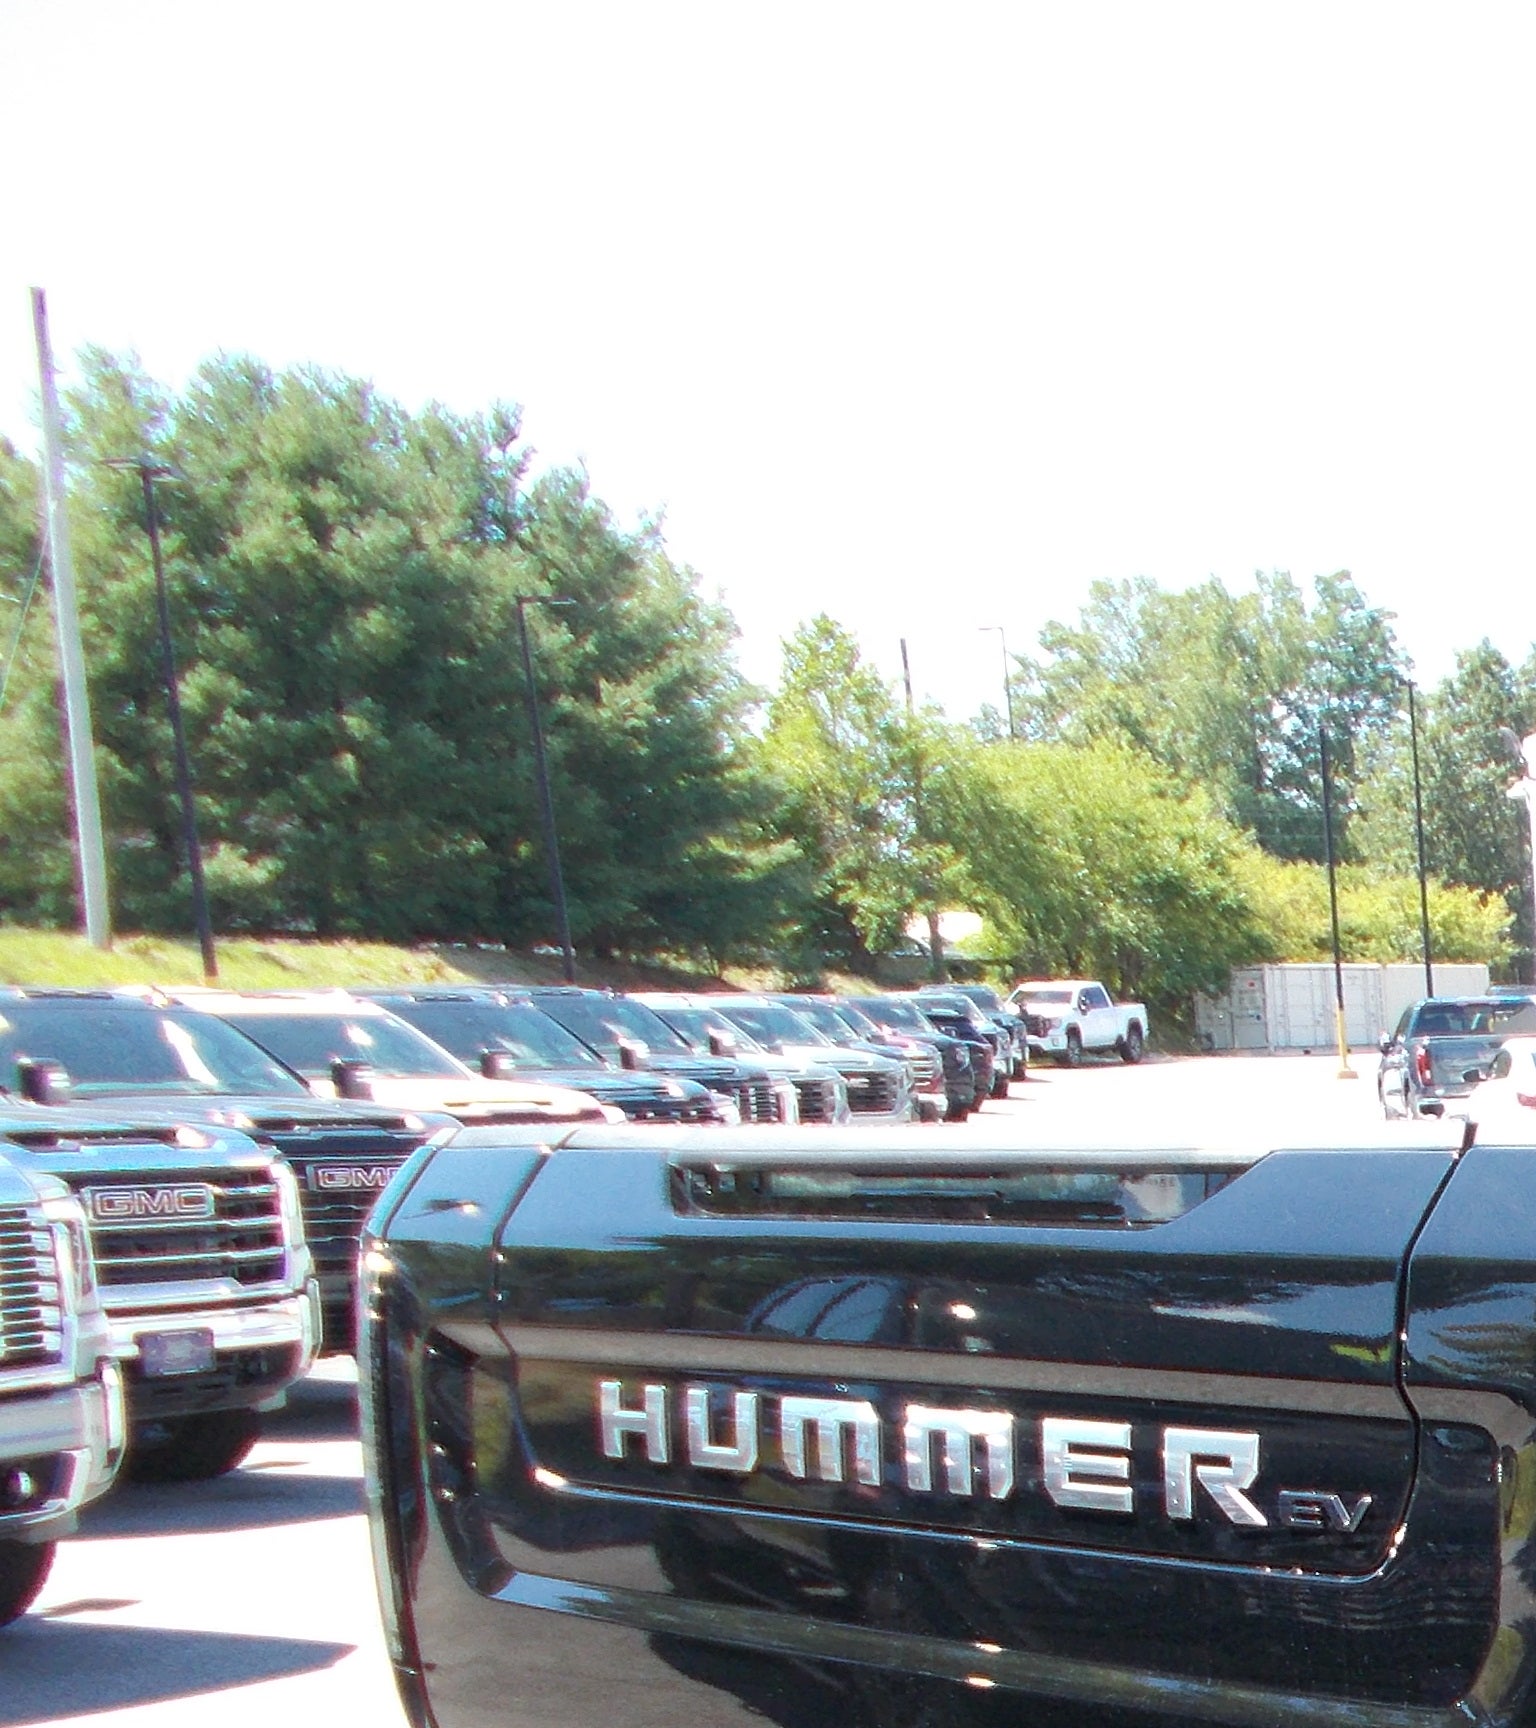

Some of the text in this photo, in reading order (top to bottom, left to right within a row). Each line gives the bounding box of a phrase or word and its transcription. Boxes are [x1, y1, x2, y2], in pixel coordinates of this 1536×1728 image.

[317, 1167, 400, 1189] GM
[94, 1190, 207, 1216] GMC
[599, 1379, 1373, 1534] HUMMER EV
